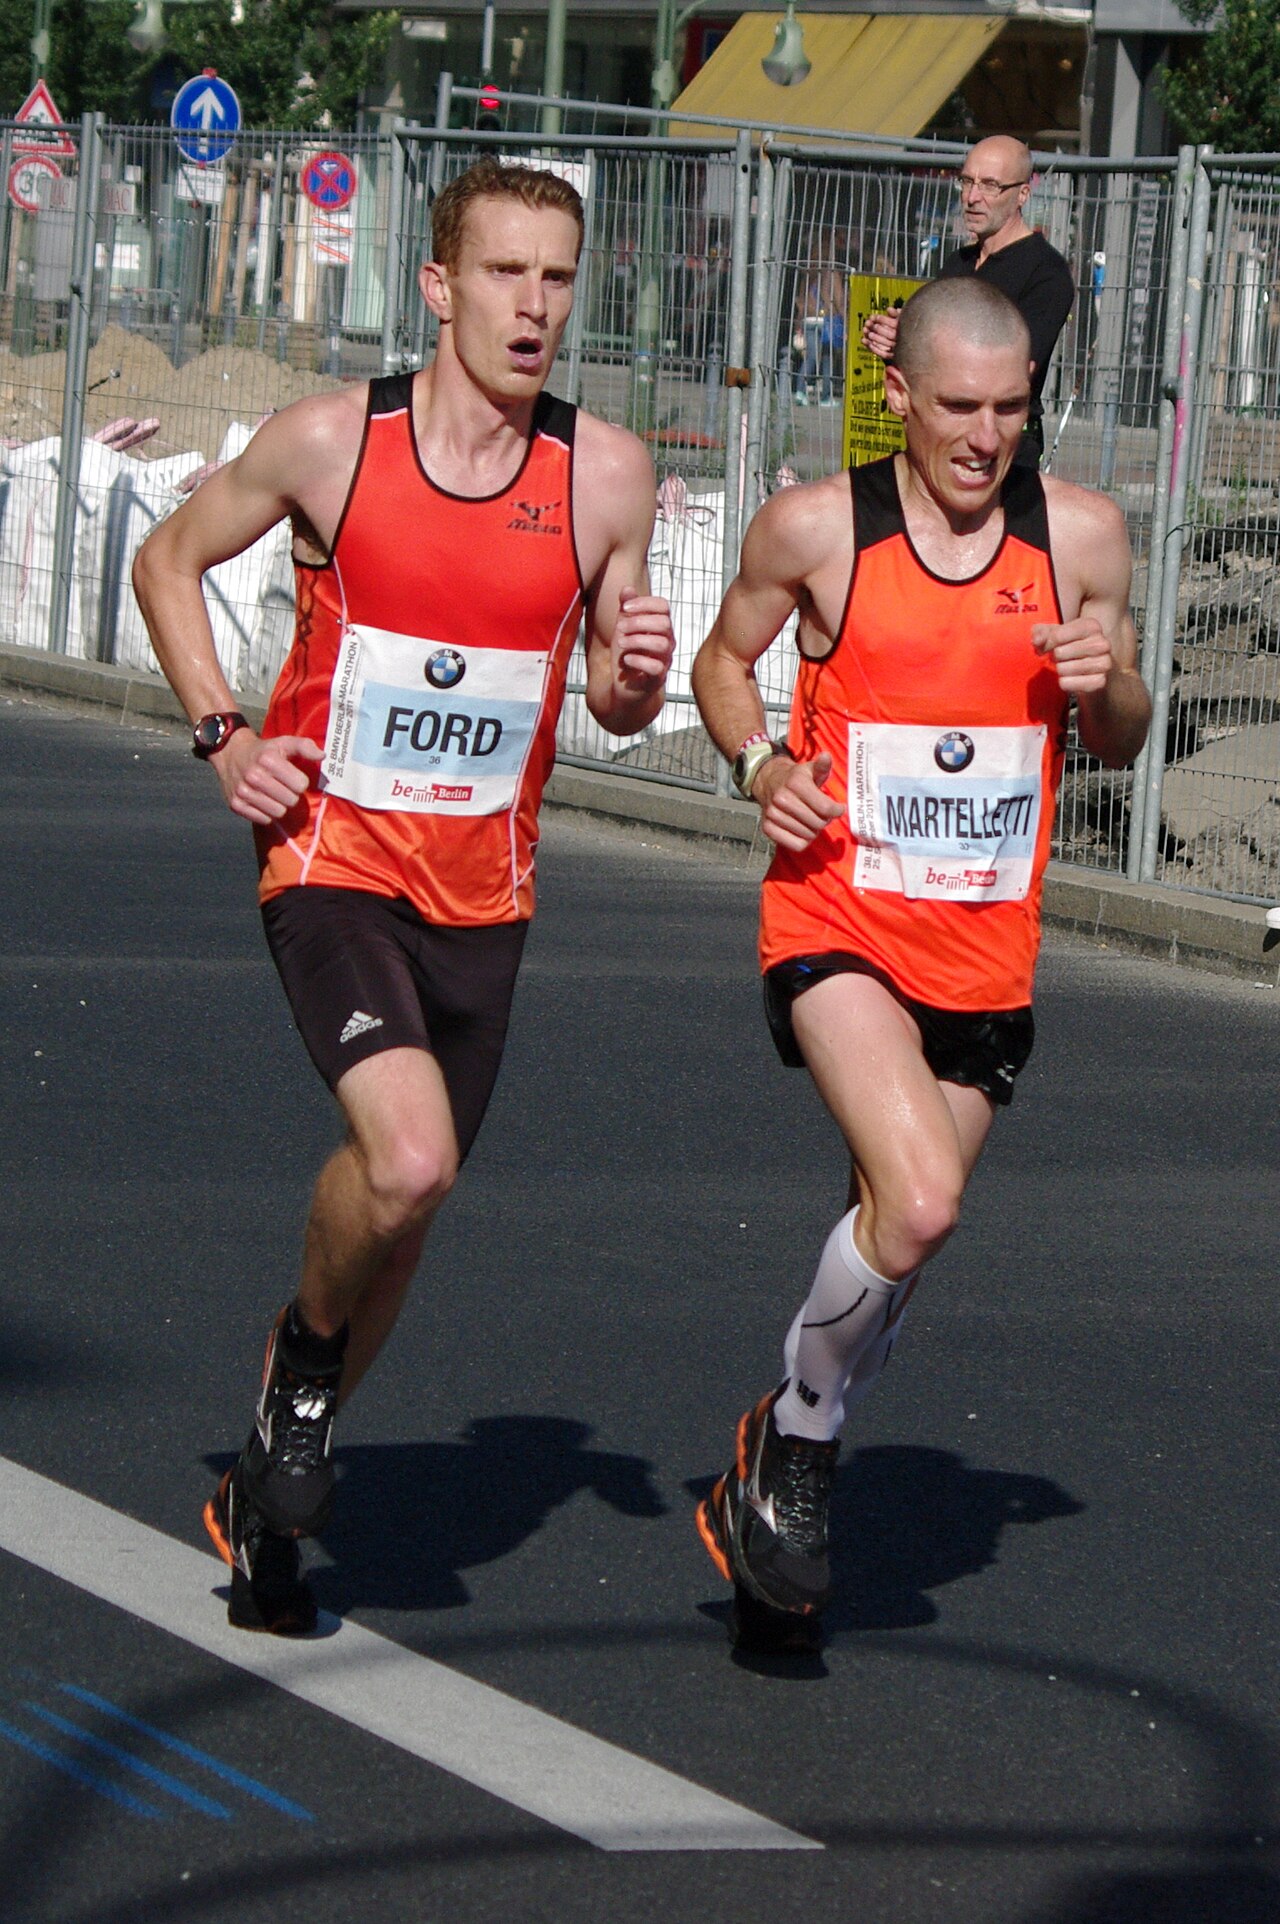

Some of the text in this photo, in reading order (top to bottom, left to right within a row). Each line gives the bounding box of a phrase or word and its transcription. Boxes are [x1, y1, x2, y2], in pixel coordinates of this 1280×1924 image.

[335, 641, 358, 738] BERLIN-MARATHON
[330, 737, 341, 760] BMW
[338, 719, 352, 766] September
[383, 706, 503, 757] FORD
[428, 755, 441, 764] 36
[437, 786, 469, 800] Berlin
[886, 794, 1034, 839] MARTELLETTI
[339, 1017, 384, 1043] adidas
